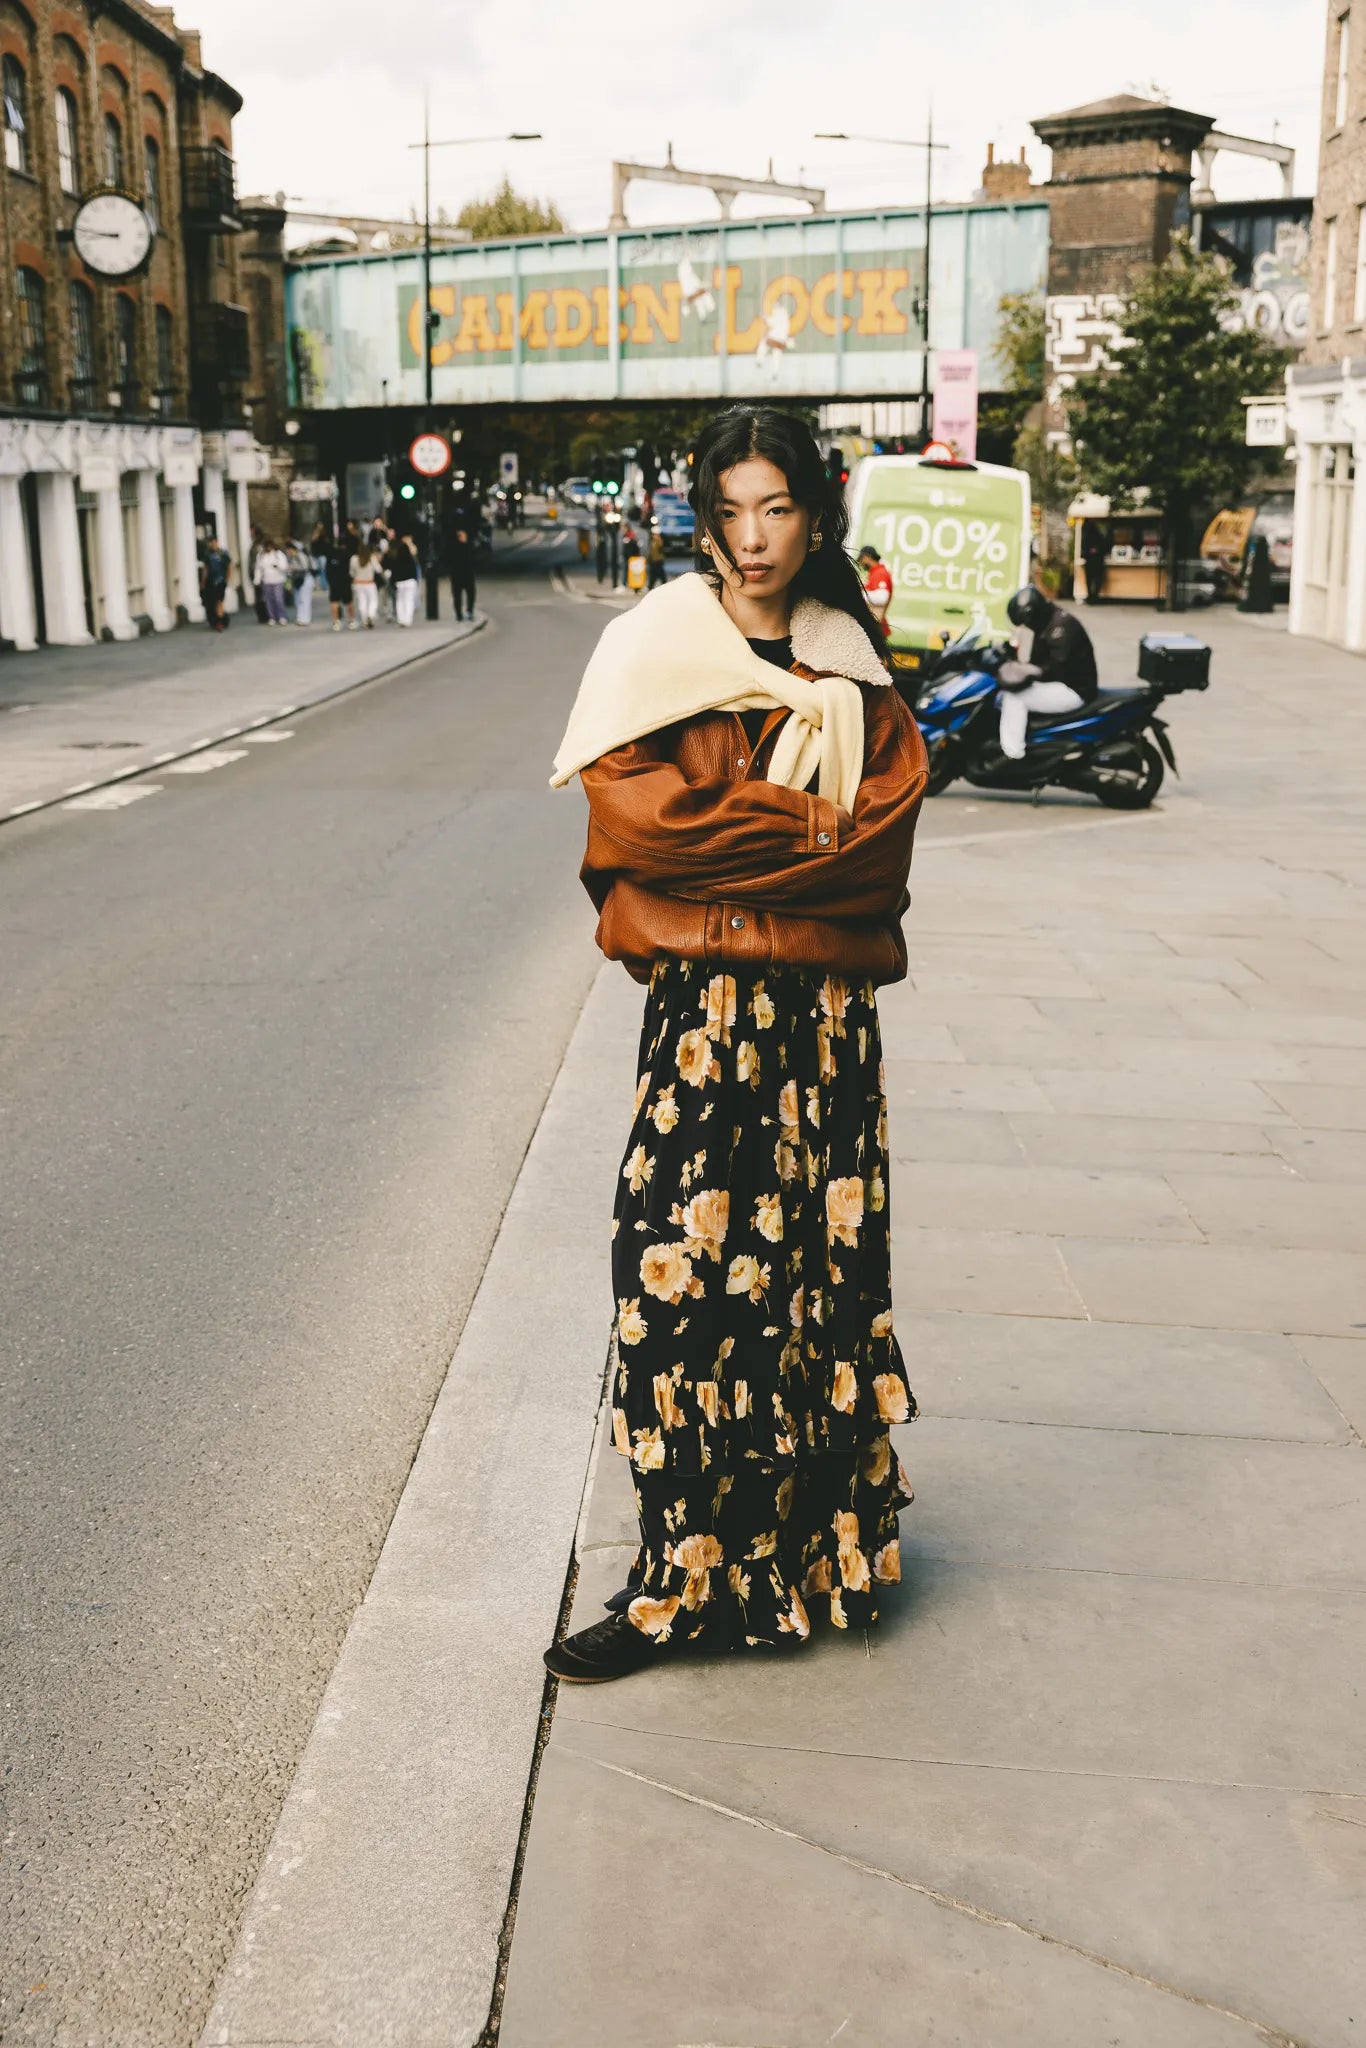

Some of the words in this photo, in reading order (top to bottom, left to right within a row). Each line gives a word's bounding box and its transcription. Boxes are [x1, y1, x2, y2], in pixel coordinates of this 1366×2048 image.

[408, 281, 682, 366] CAMDEN
[713, 266, 909, 355] LOCK
[873, 513, 1008, 563] 100%
[881, 555, 1005, 595] lectric
